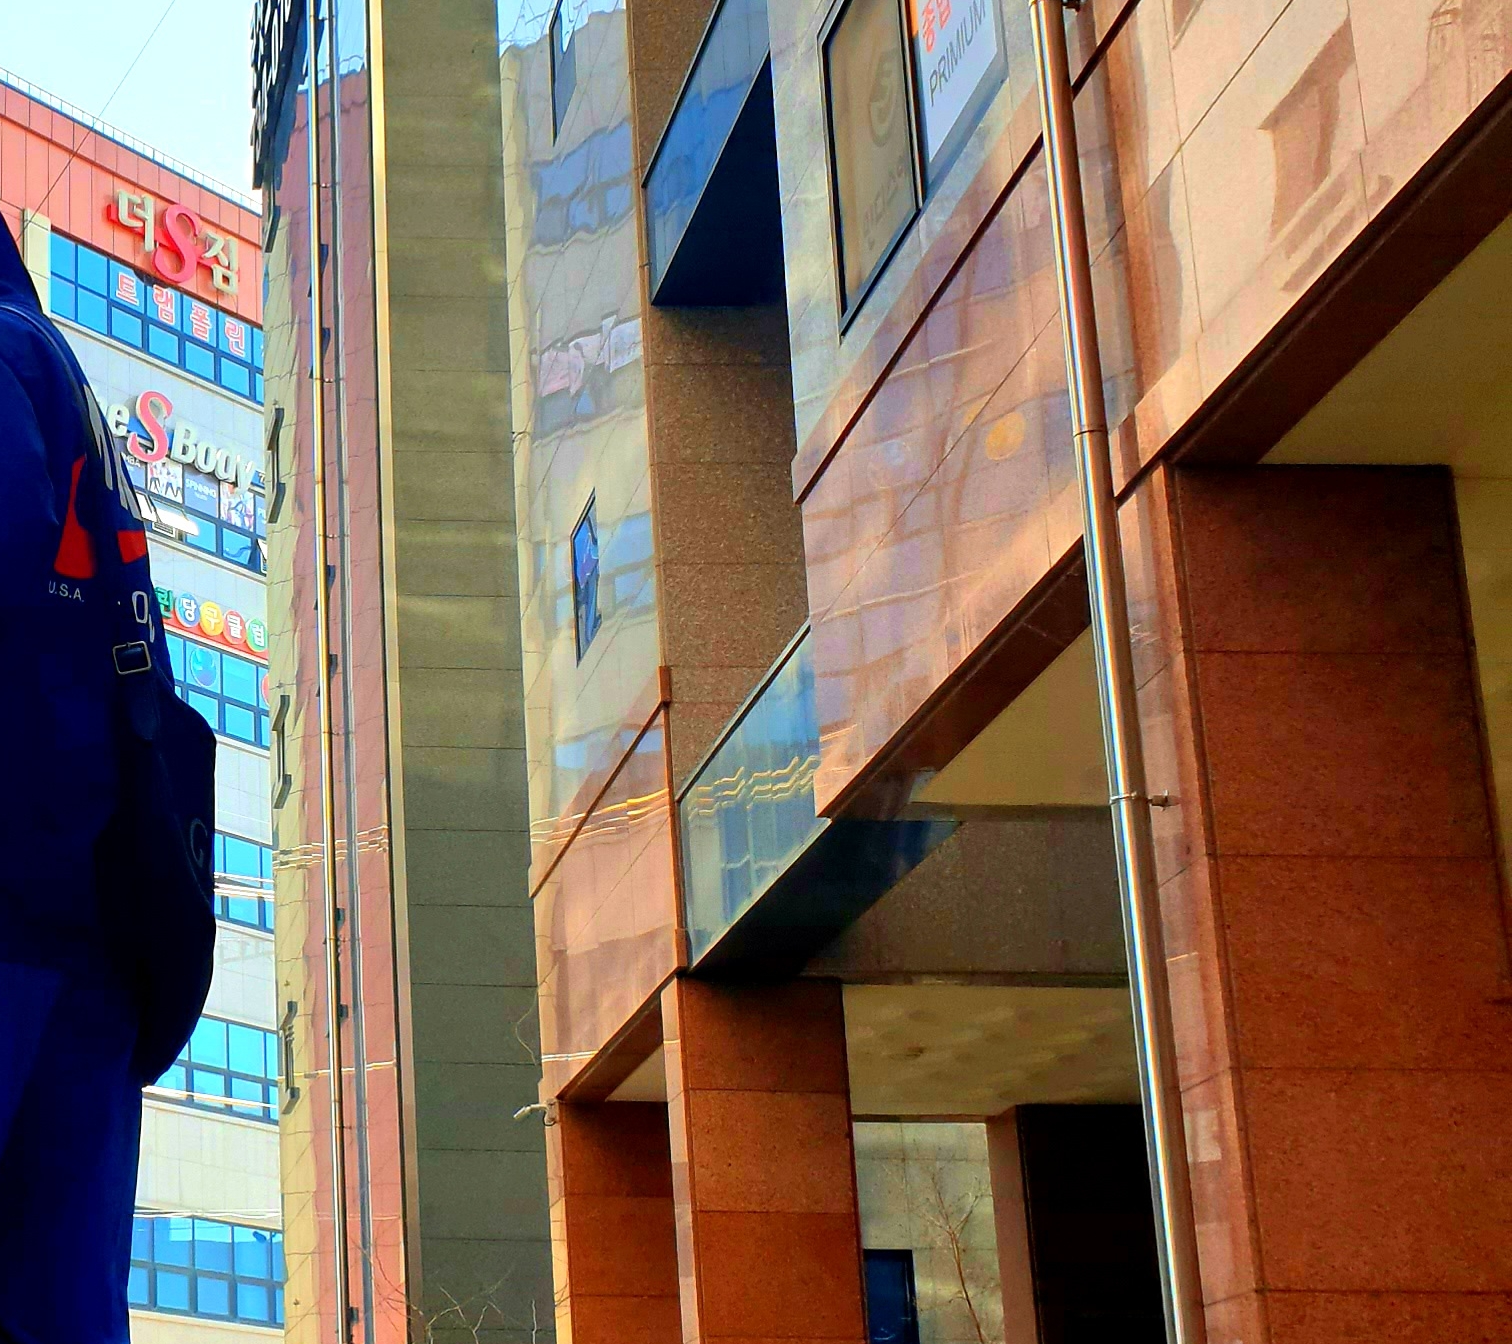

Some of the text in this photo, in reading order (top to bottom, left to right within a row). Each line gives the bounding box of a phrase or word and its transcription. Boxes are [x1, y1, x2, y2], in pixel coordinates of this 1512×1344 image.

[115, 271, 246, 358] 트램폴린
[120, 452, 141, 468] MBA
[48, 580, 85, 603] U.S.A.
